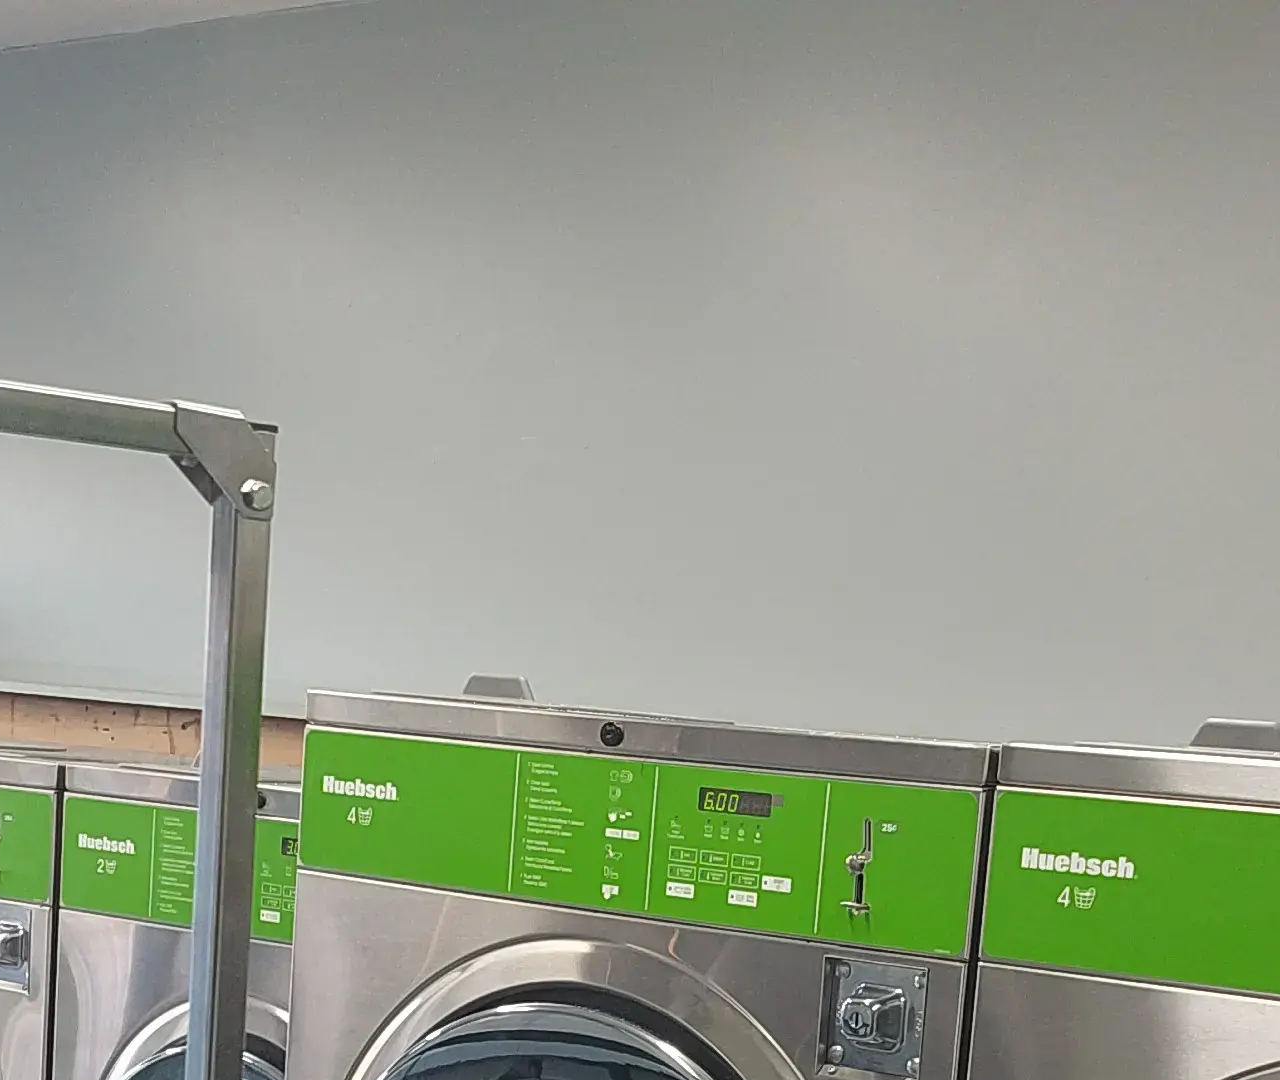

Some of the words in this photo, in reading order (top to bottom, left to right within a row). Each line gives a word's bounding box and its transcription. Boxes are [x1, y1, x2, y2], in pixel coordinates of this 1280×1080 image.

[322, 775, 398, 801] Huebsch
[346, 806, 357, 825] 4
[78, 833, 136, 856] Huebsch
[96, 858, 105, 874] 2
[1020, 847, 1136, 880] Huebsch
[1056, 885, 1071, 908] 4
